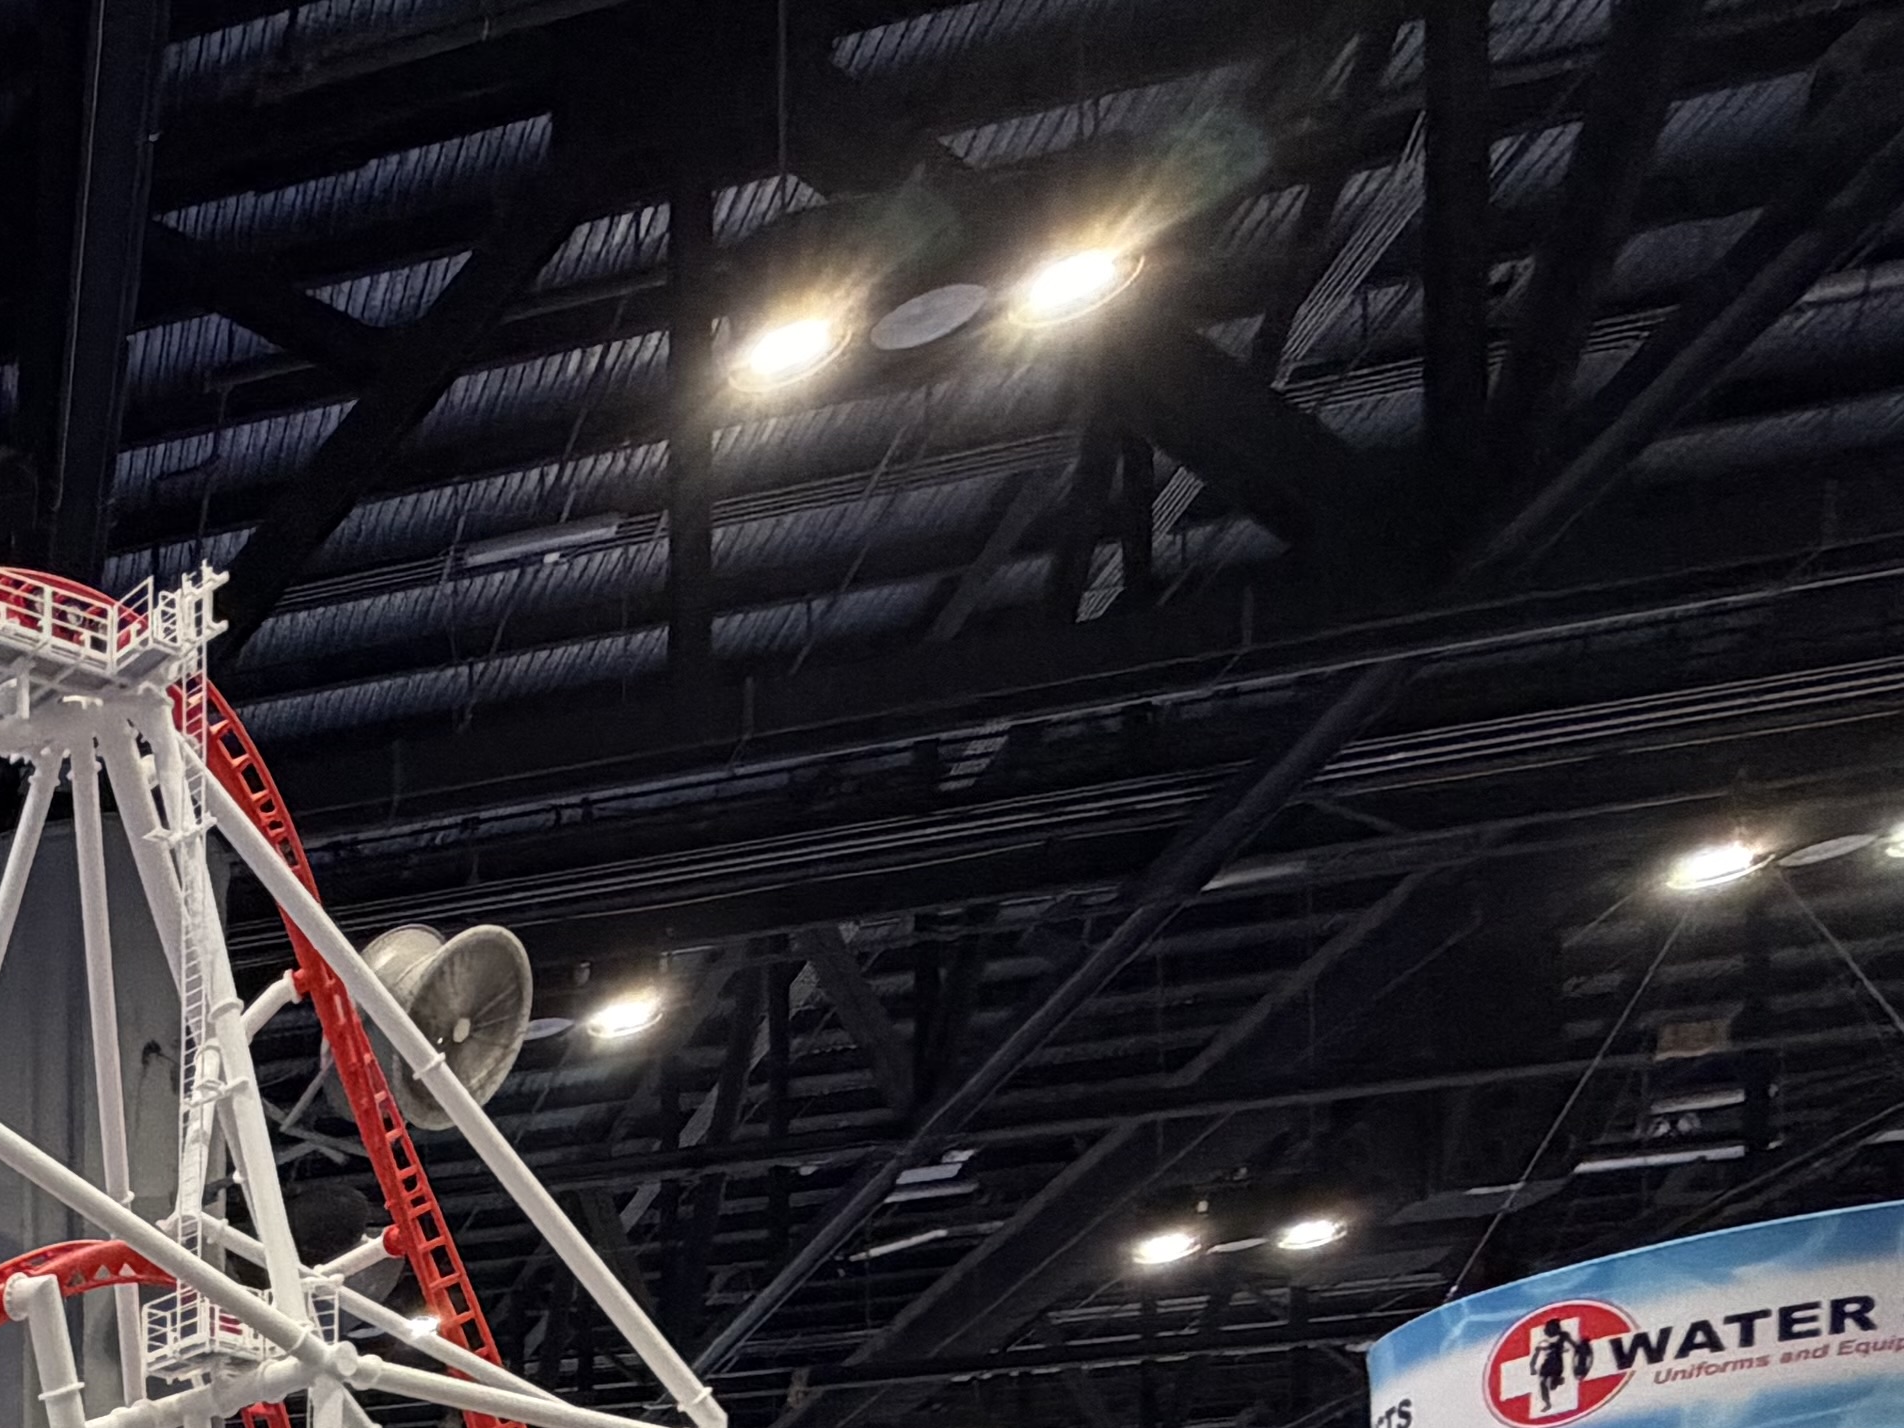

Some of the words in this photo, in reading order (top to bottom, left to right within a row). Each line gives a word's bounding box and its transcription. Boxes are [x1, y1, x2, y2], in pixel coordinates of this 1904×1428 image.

[1609, 1295, 1878, 1370] WATER
[1653, 1353, 1770, 1386] Uniforms
[1780, 1343, 1830, 1365] and
